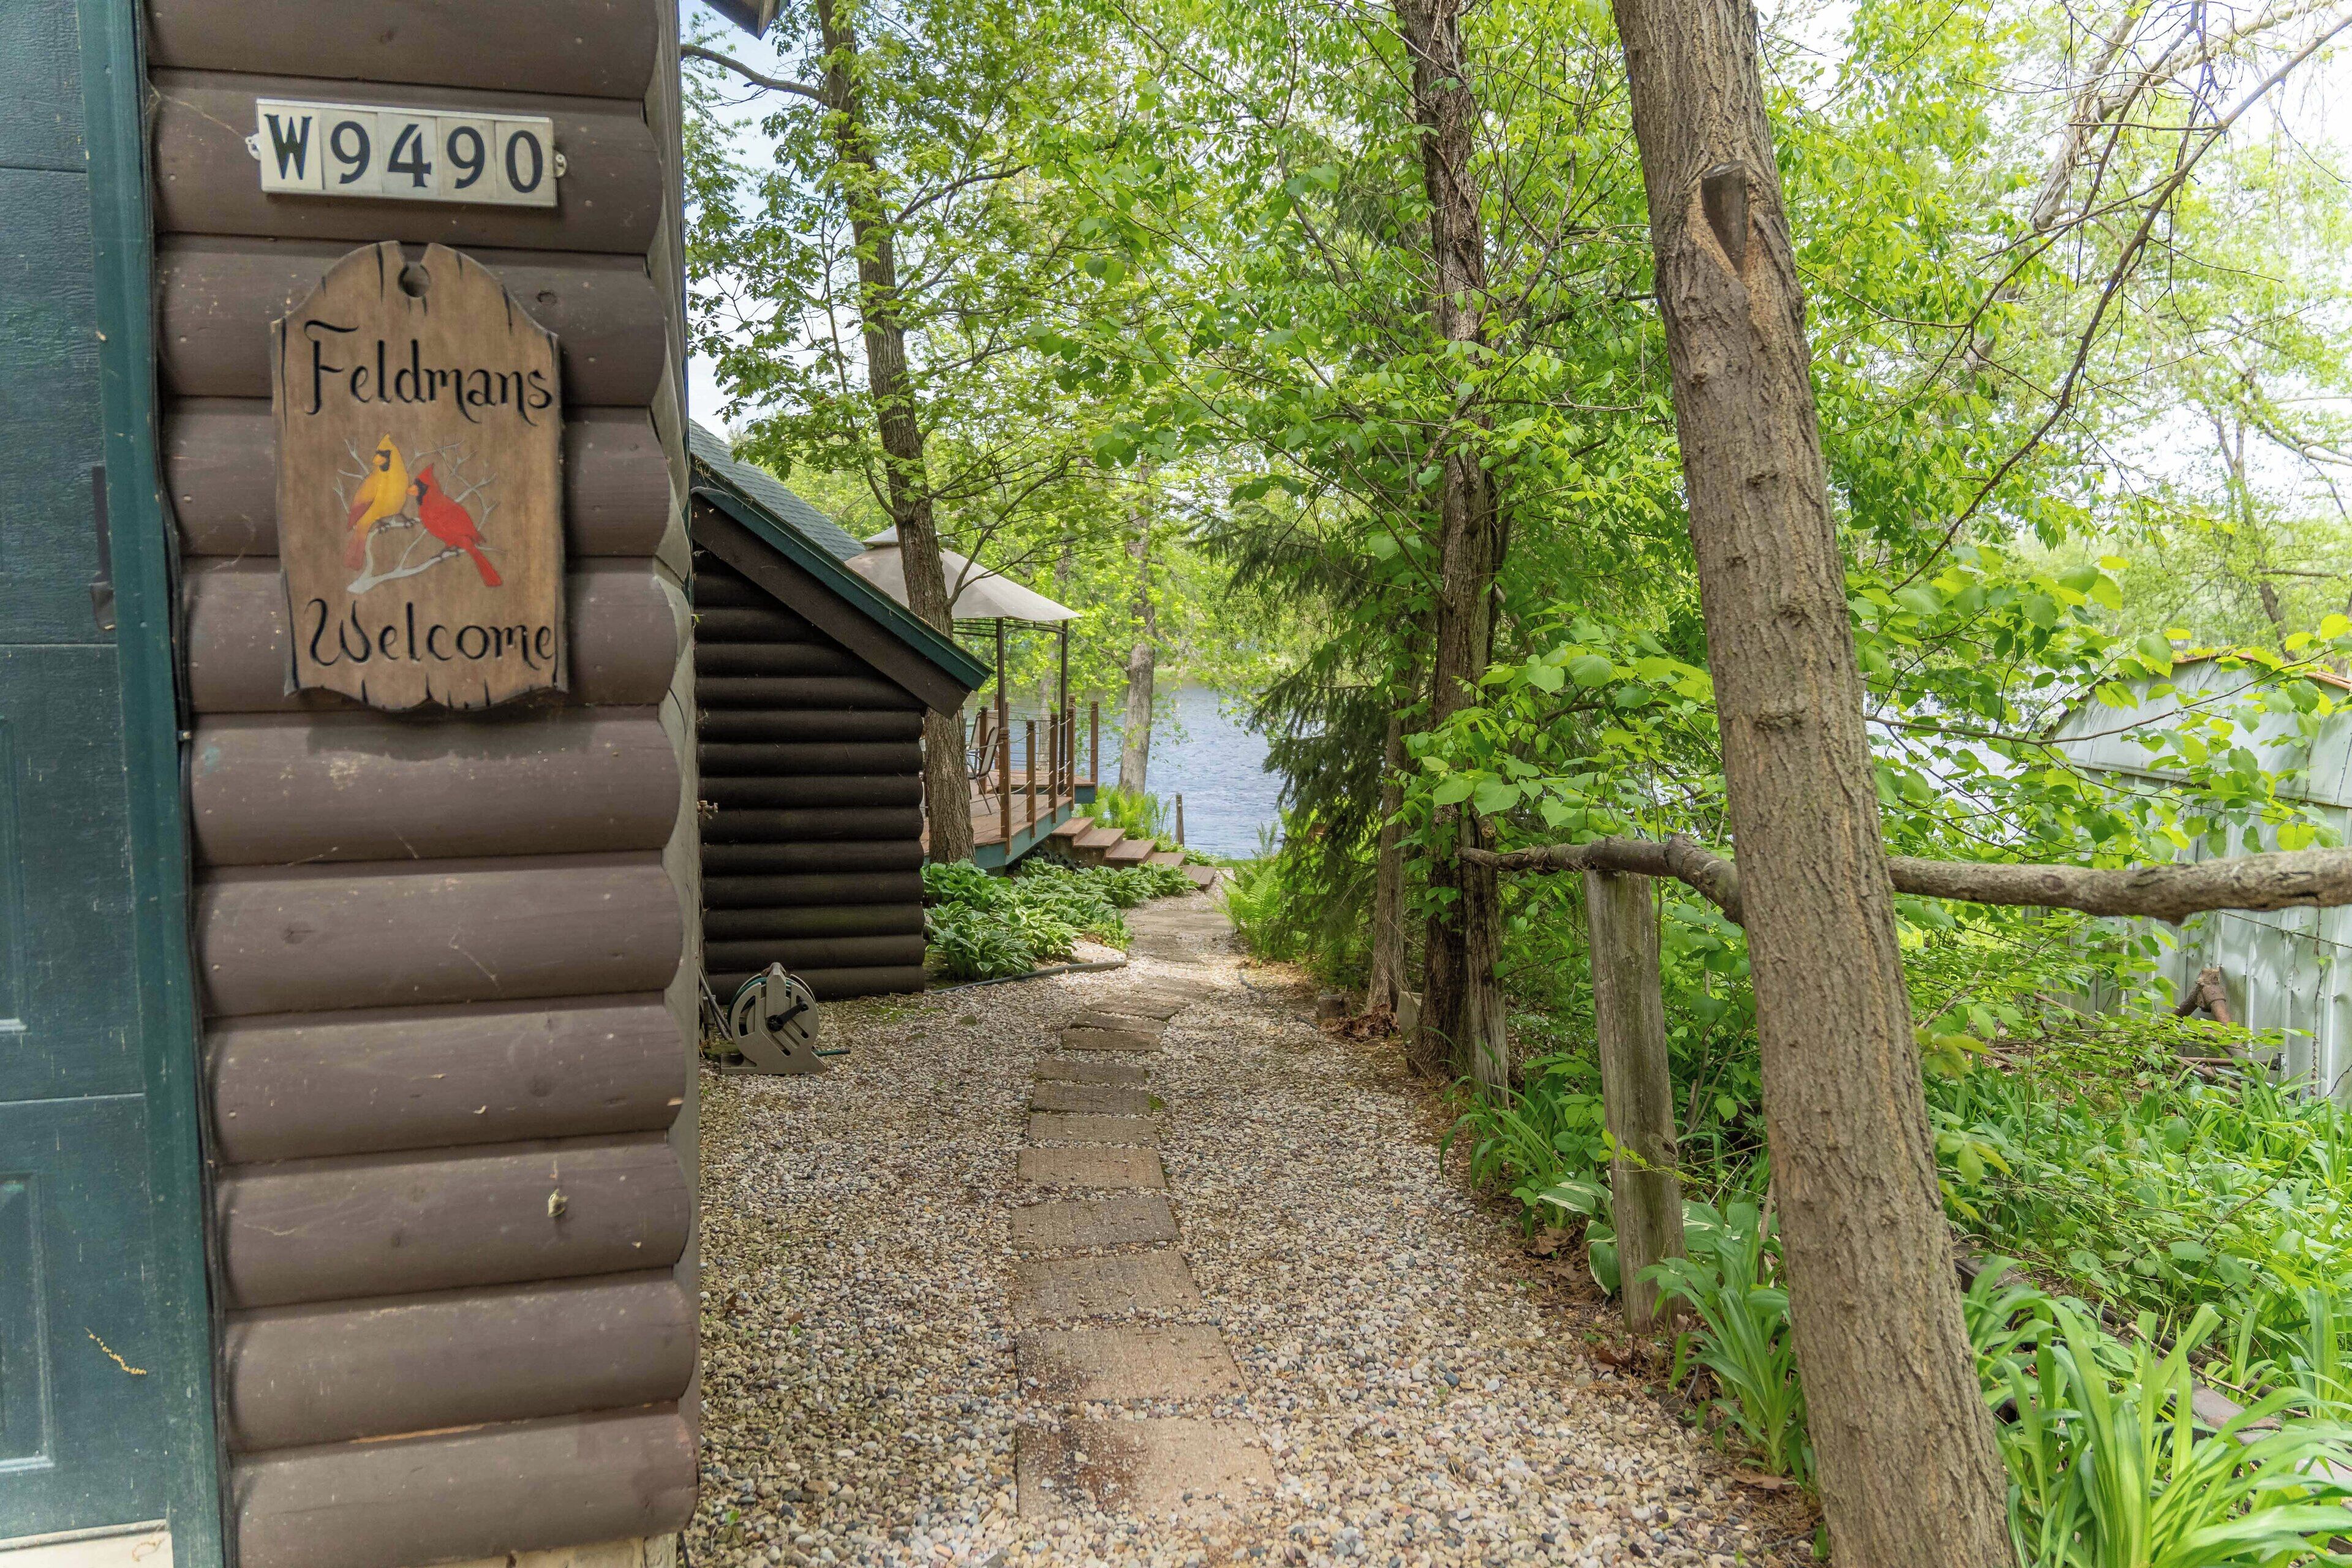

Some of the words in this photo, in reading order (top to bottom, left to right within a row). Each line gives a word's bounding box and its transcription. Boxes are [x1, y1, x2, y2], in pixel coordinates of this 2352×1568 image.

[264, 113, 543, 194] W9490
[304, 320, 552, 426] Feldmans
[305, 598, 554, 670] Welcome
